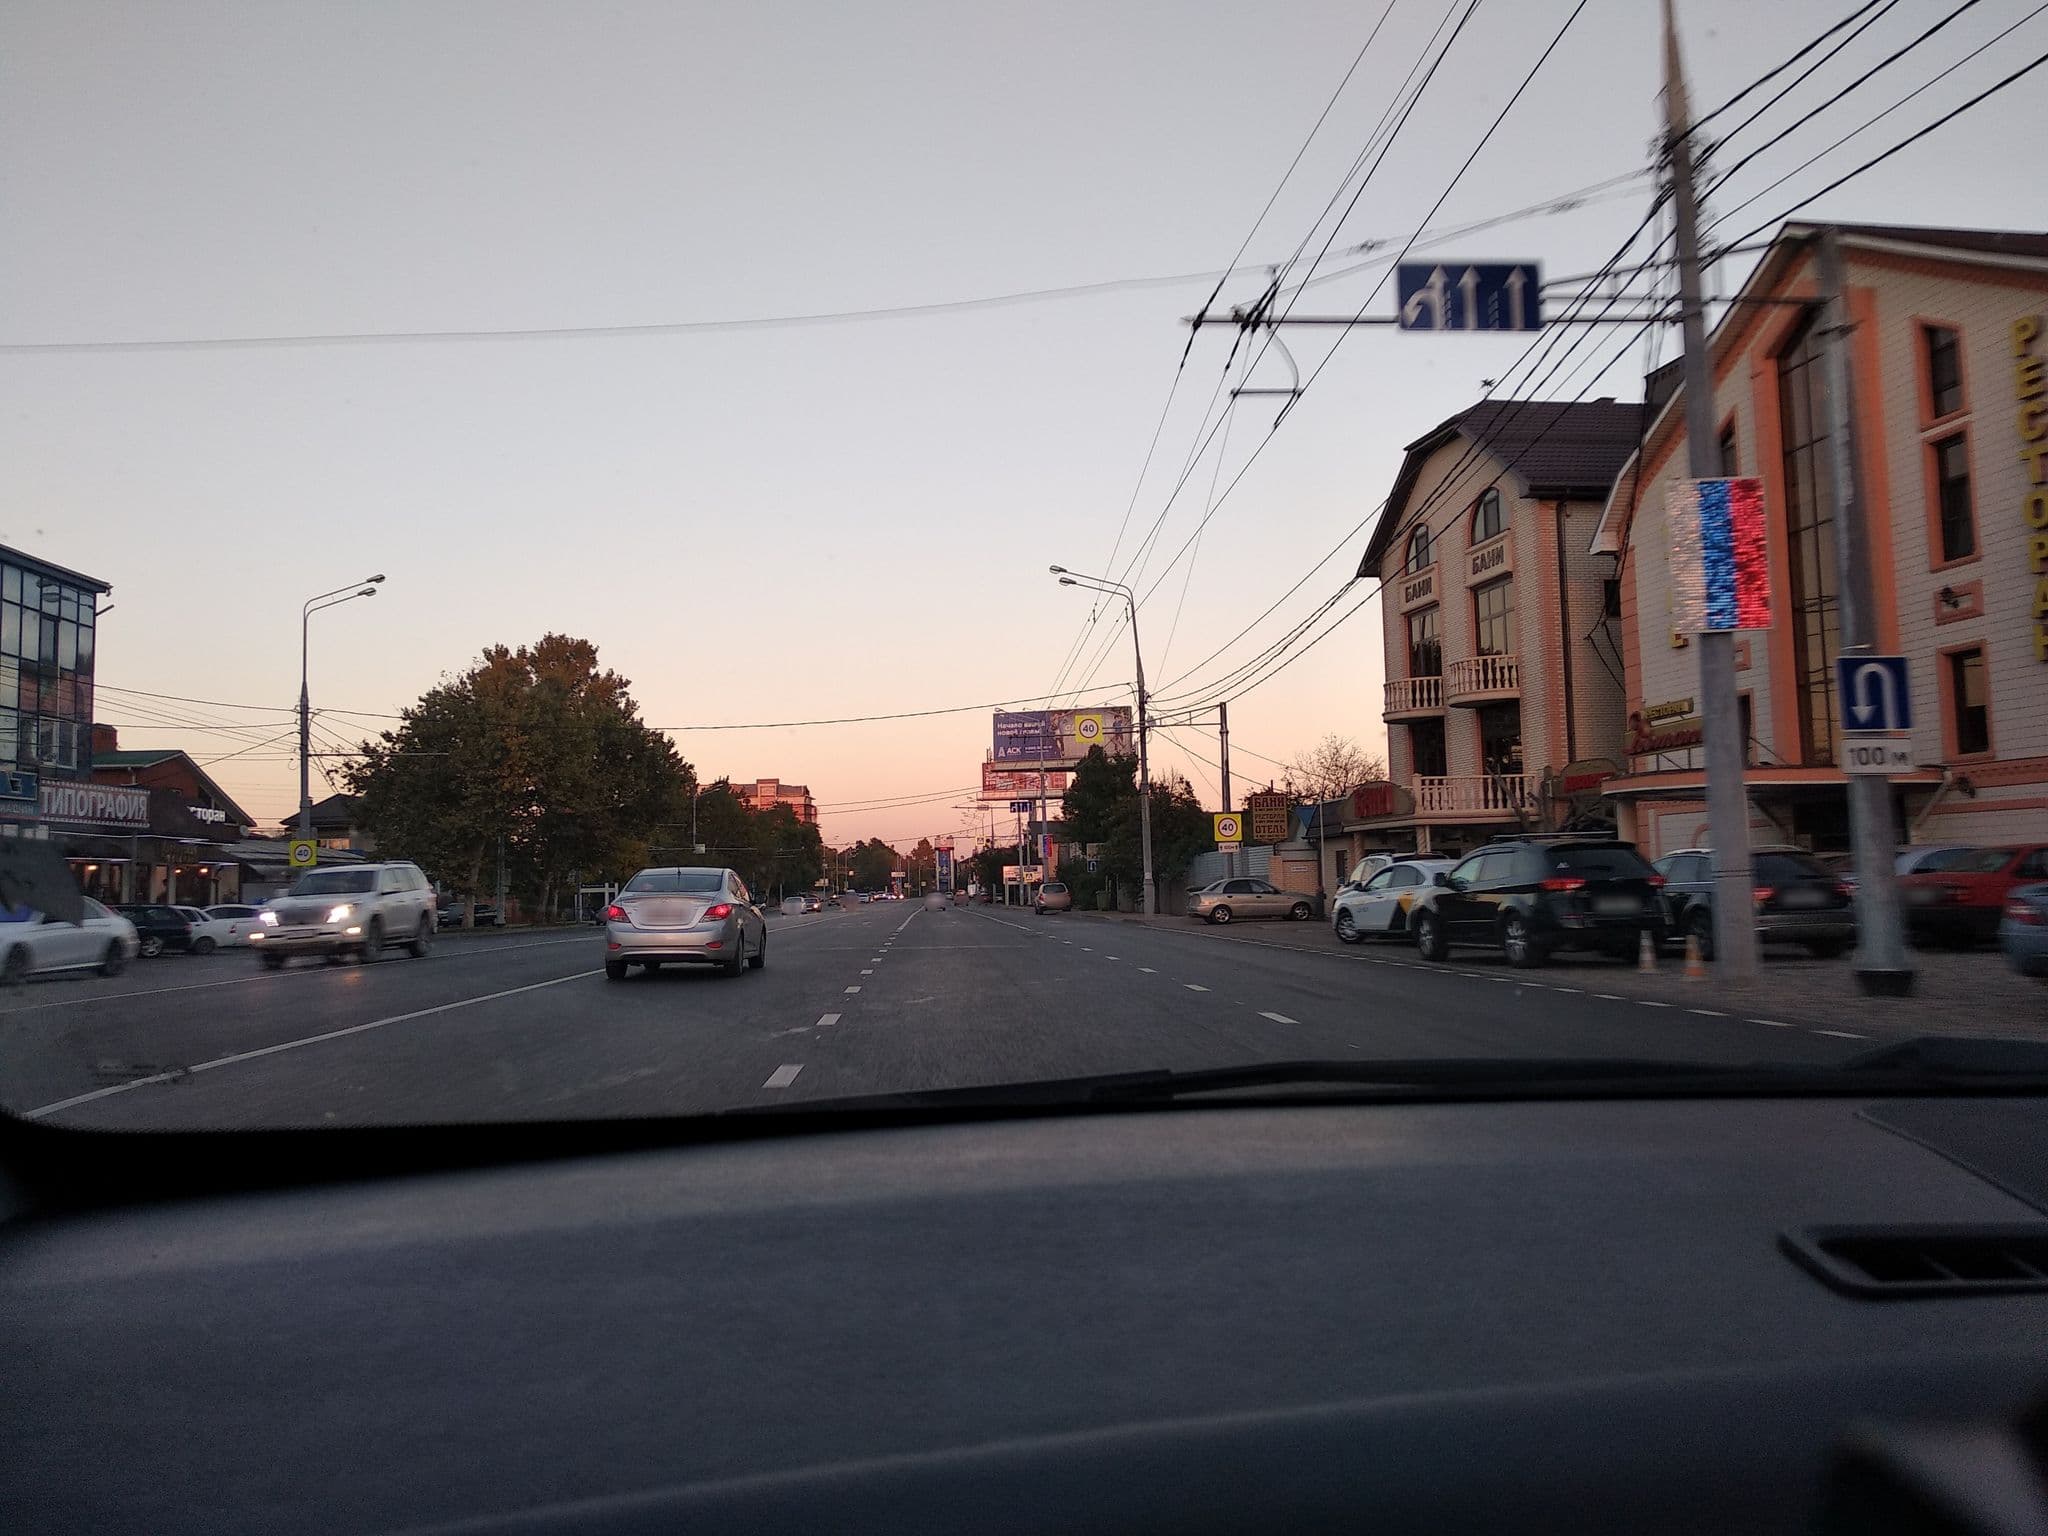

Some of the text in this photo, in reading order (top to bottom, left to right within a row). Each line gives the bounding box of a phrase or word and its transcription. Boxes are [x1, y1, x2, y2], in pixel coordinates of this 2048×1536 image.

[1472, 545, 1504, 575] БАНИ
[1405, 577, 1432, 603] БАНИ
[1083, 724, 1095, 733] 40
[1848, 747, 1885, 766] 100
[41, 786, 148, 821] ТИПОГРАФИЯ
[1254, 797, 1284, 808] БАНИ
[1221, 823, 1234, 832] 40
[1255, 825, 1286, 834] ОТЕЛЬ
[297, 849, 309, 857] 40
